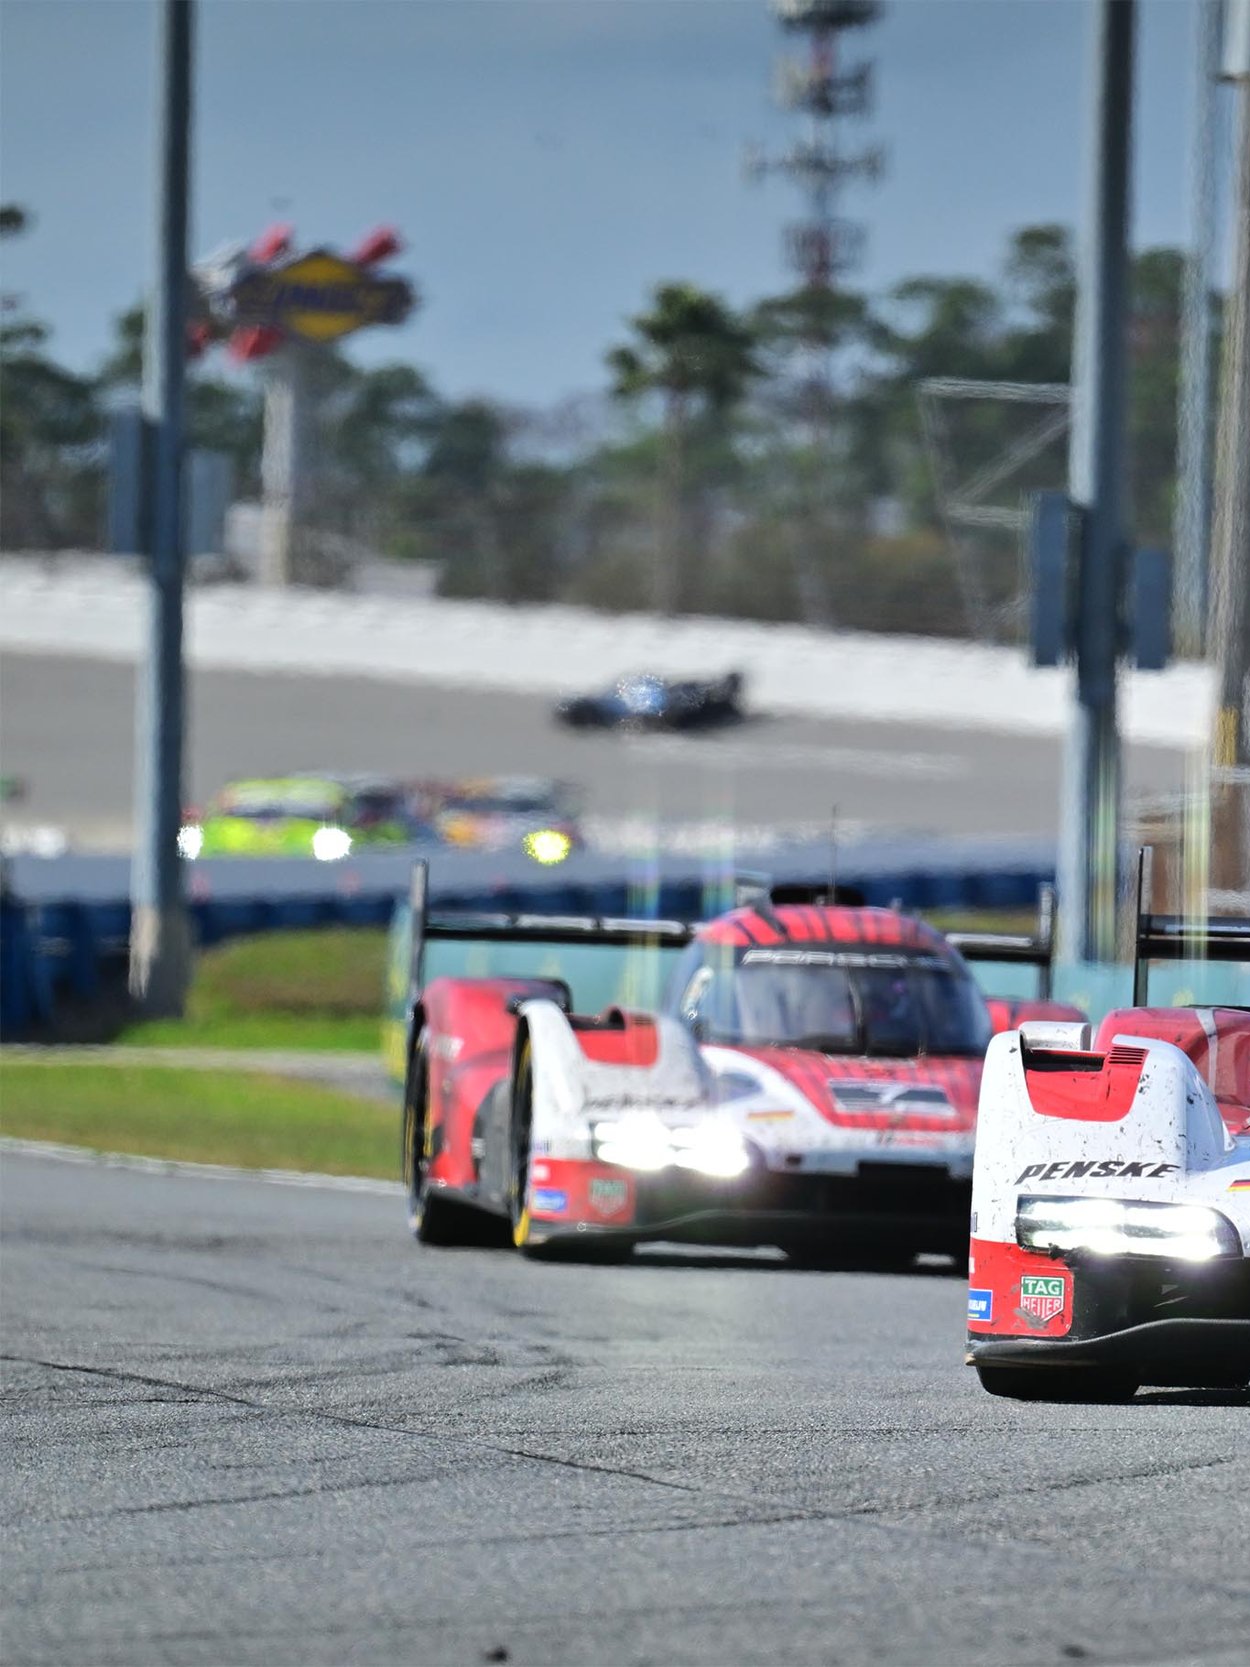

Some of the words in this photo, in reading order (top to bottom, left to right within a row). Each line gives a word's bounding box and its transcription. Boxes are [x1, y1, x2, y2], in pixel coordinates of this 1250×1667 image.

[1014, 1160, 1181, 1186] PENSKE
[1024, 1280, 1061, 1295] TAG
[1022, 1298, 1061, 1319] HEUER
